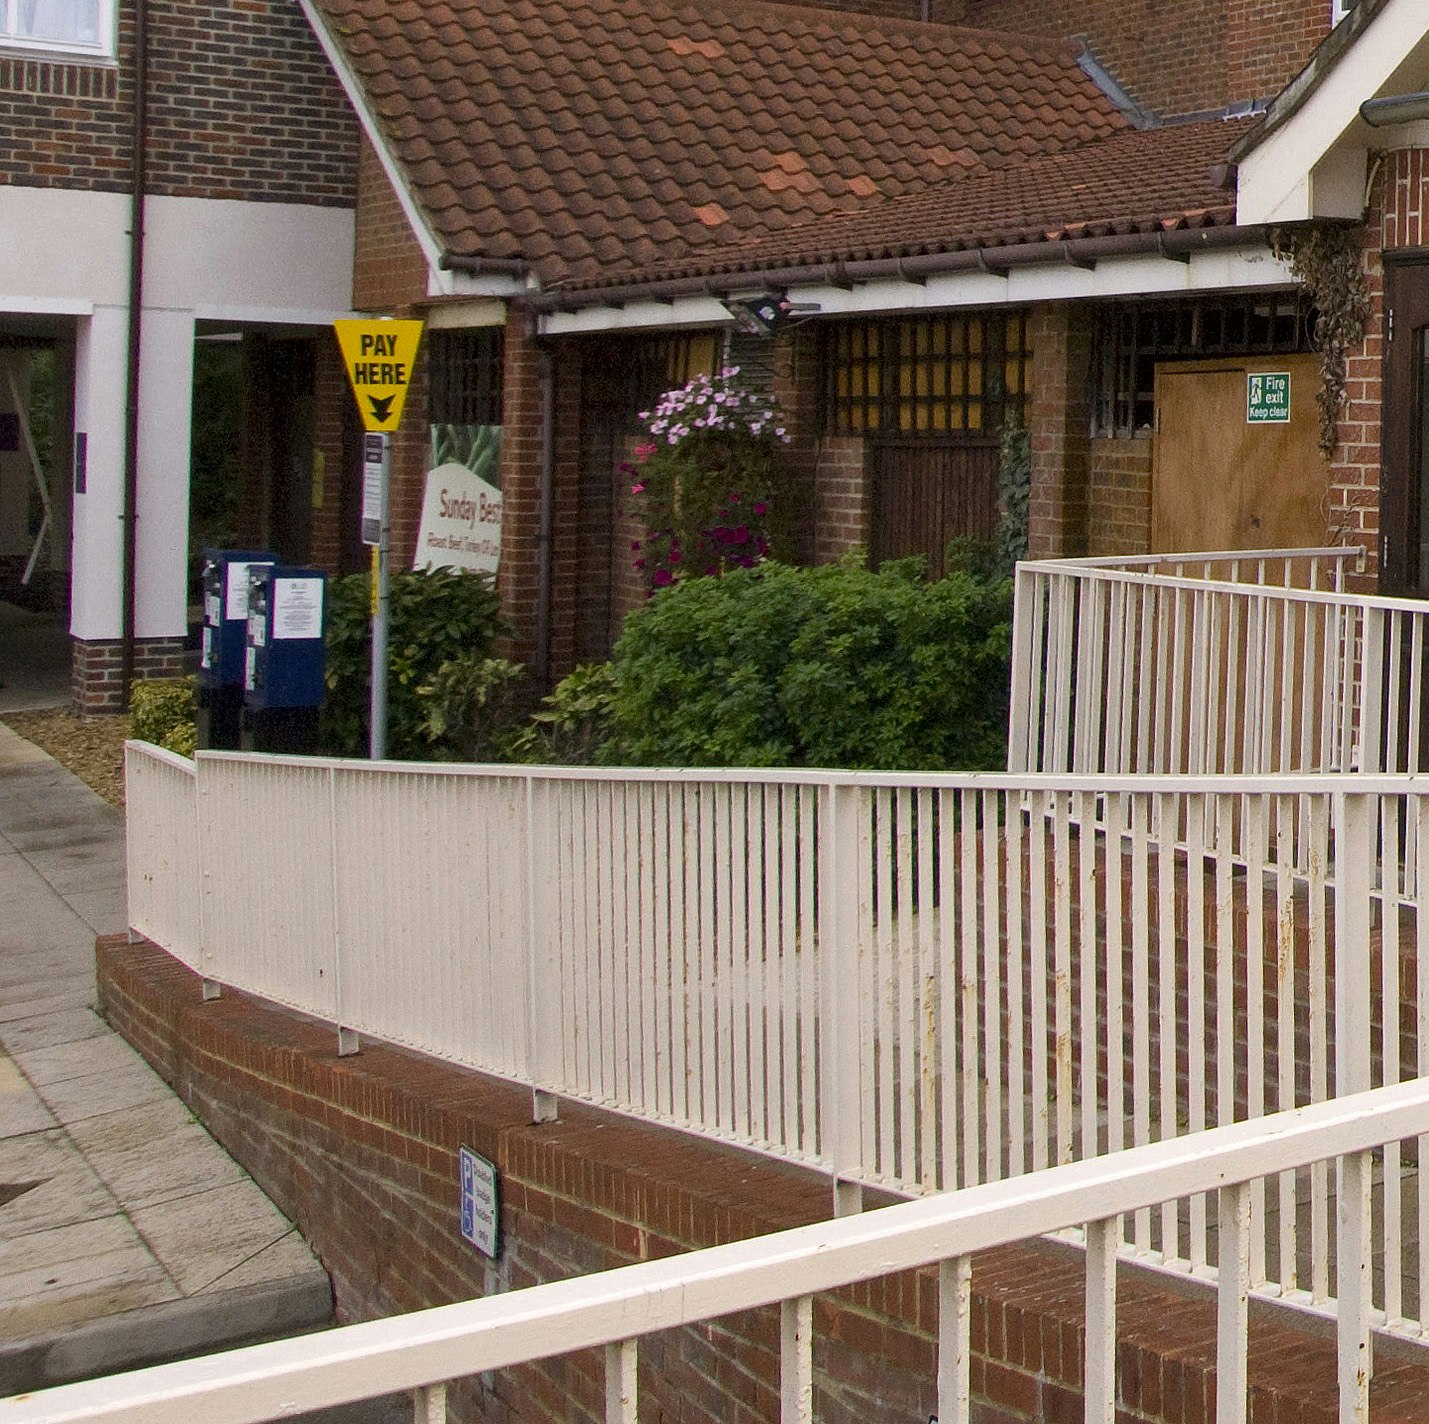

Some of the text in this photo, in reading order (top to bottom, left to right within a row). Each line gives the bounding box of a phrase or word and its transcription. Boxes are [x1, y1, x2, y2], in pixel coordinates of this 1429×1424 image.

[360, 334, 398, 357] PAY
[354, 362, 407, 385] HERE
[1266, 376, 1285, 390] Fire
[1265, 390, 1284, 404] exit
[1249, 406, 1288, 420] Keep clear
[440, 488, 477, 529] Sunday
